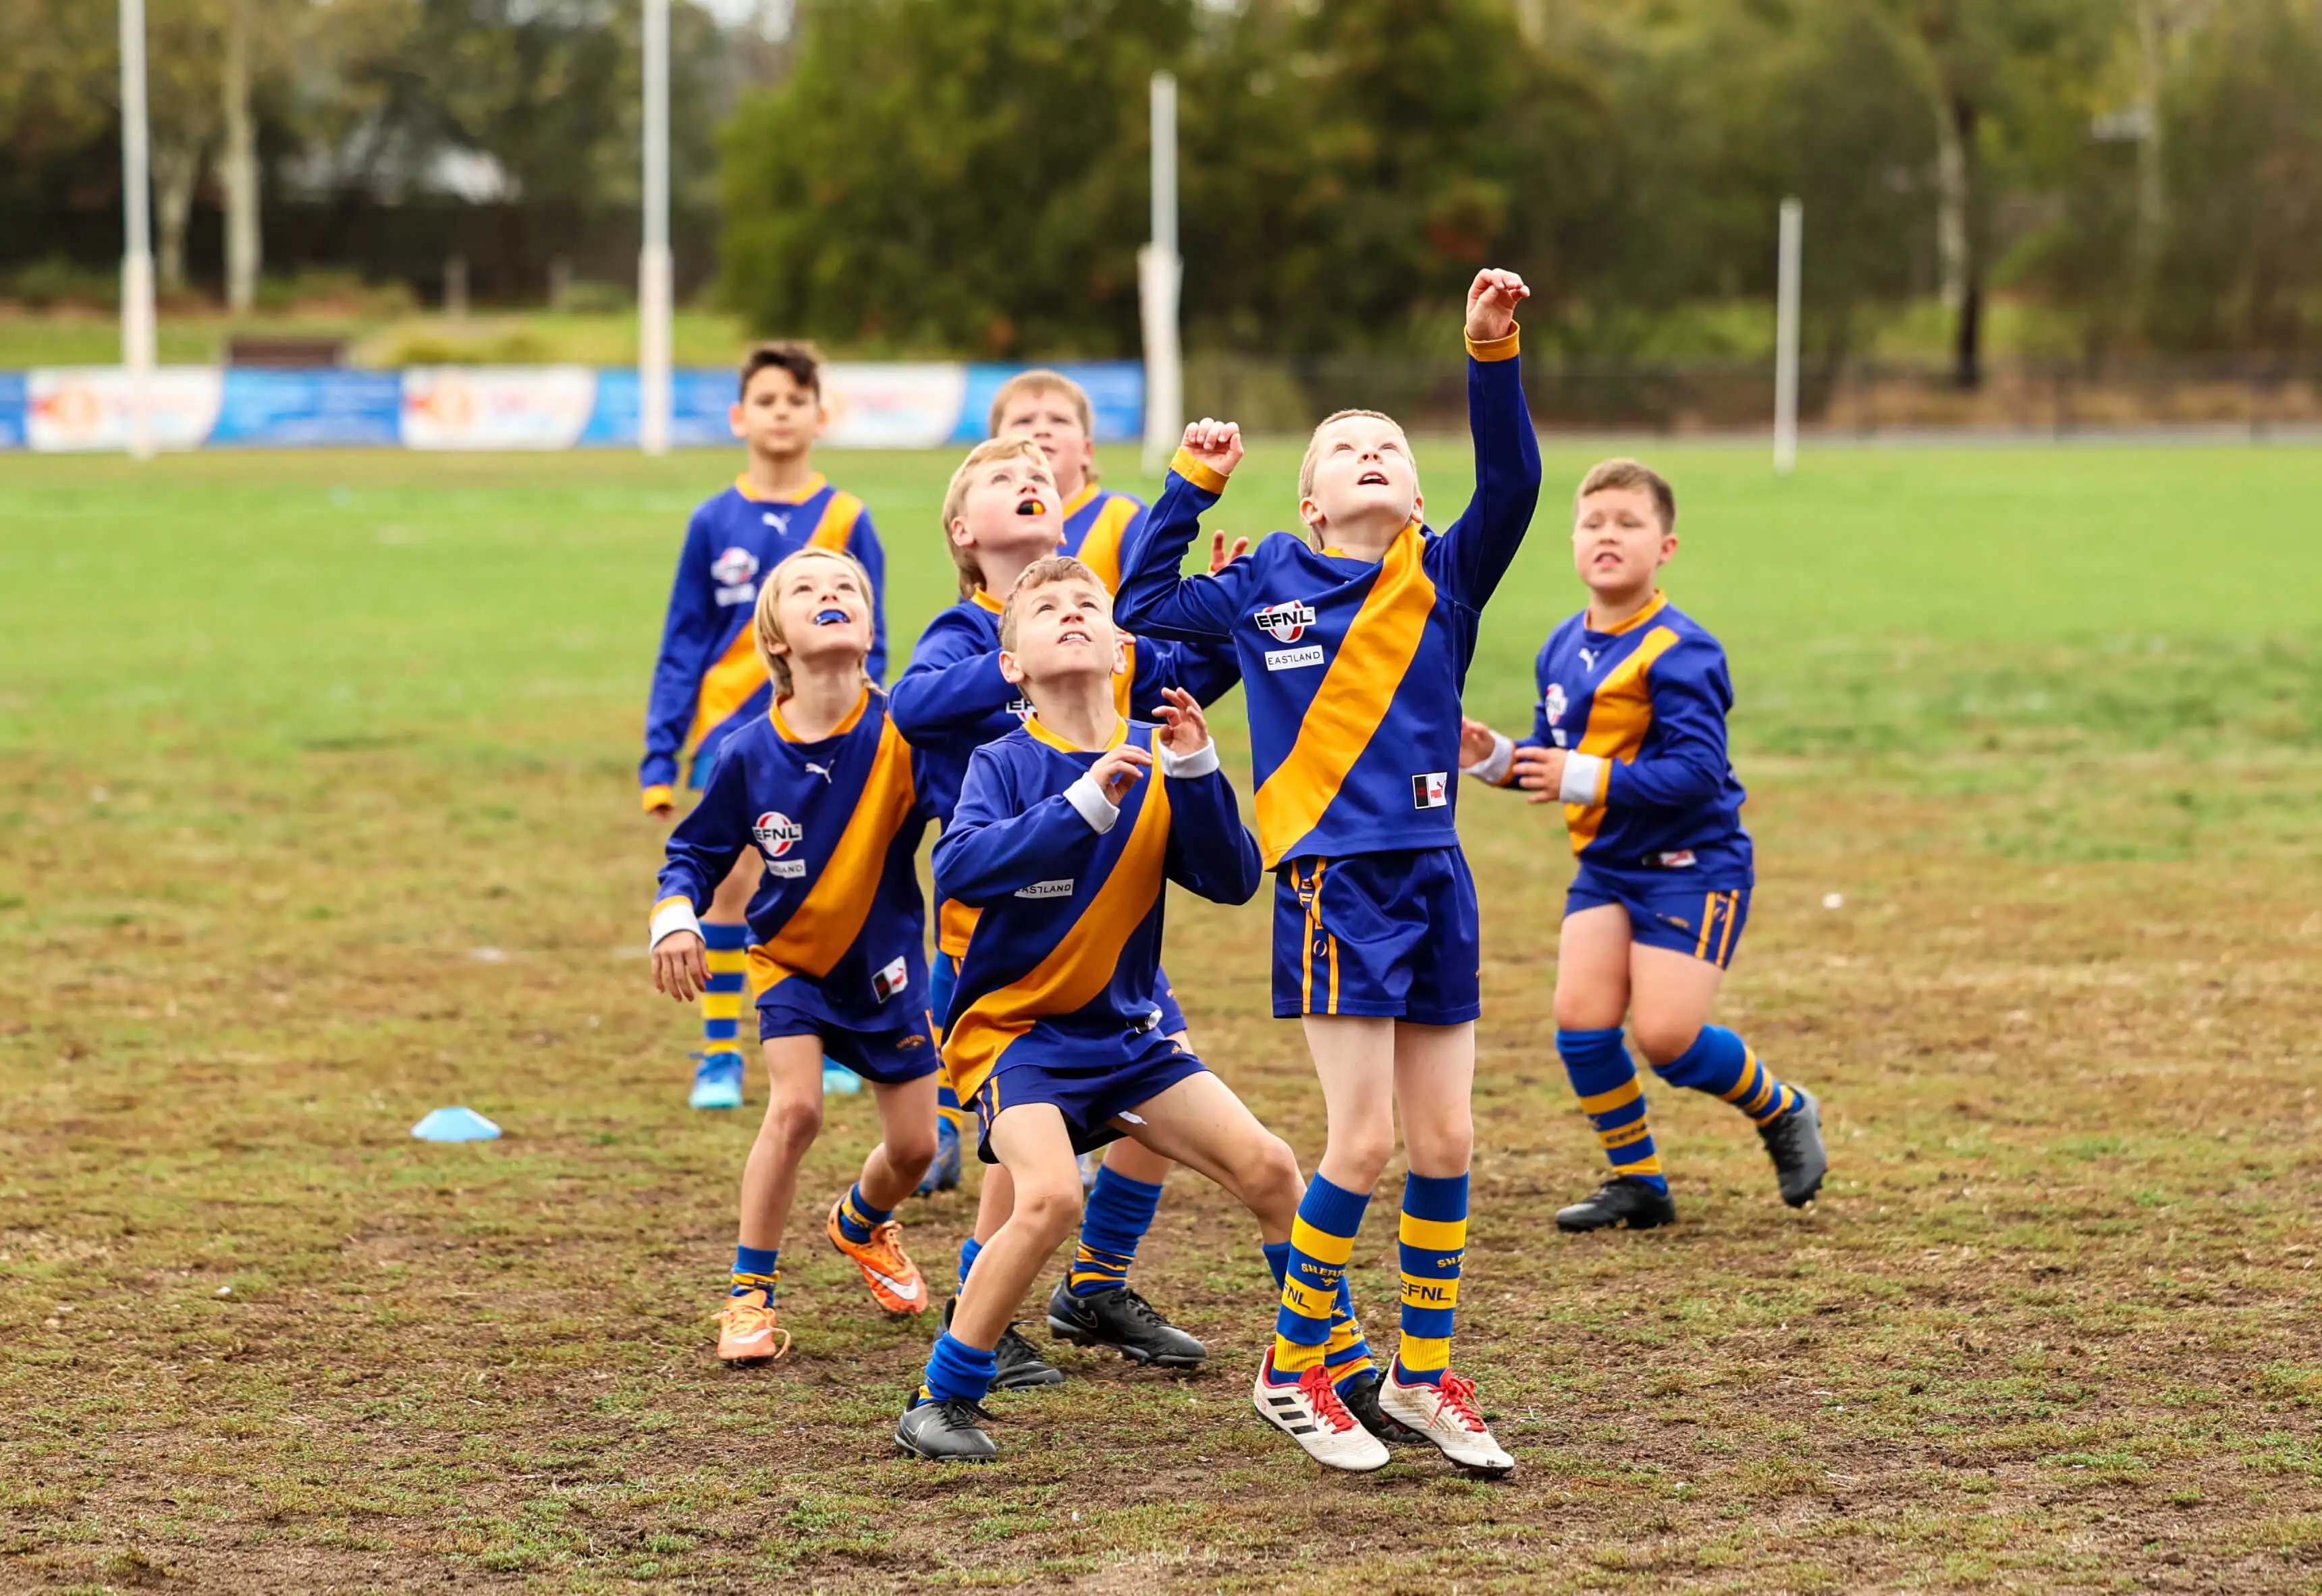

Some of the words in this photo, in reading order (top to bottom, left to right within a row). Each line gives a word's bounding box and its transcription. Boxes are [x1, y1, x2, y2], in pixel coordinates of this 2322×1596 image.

[1257, 610, 1313, 628] EFNL
[1268, 651, 1321, 665] EASTLAND
[1016, 884, 1071, 894] ASTLAND
